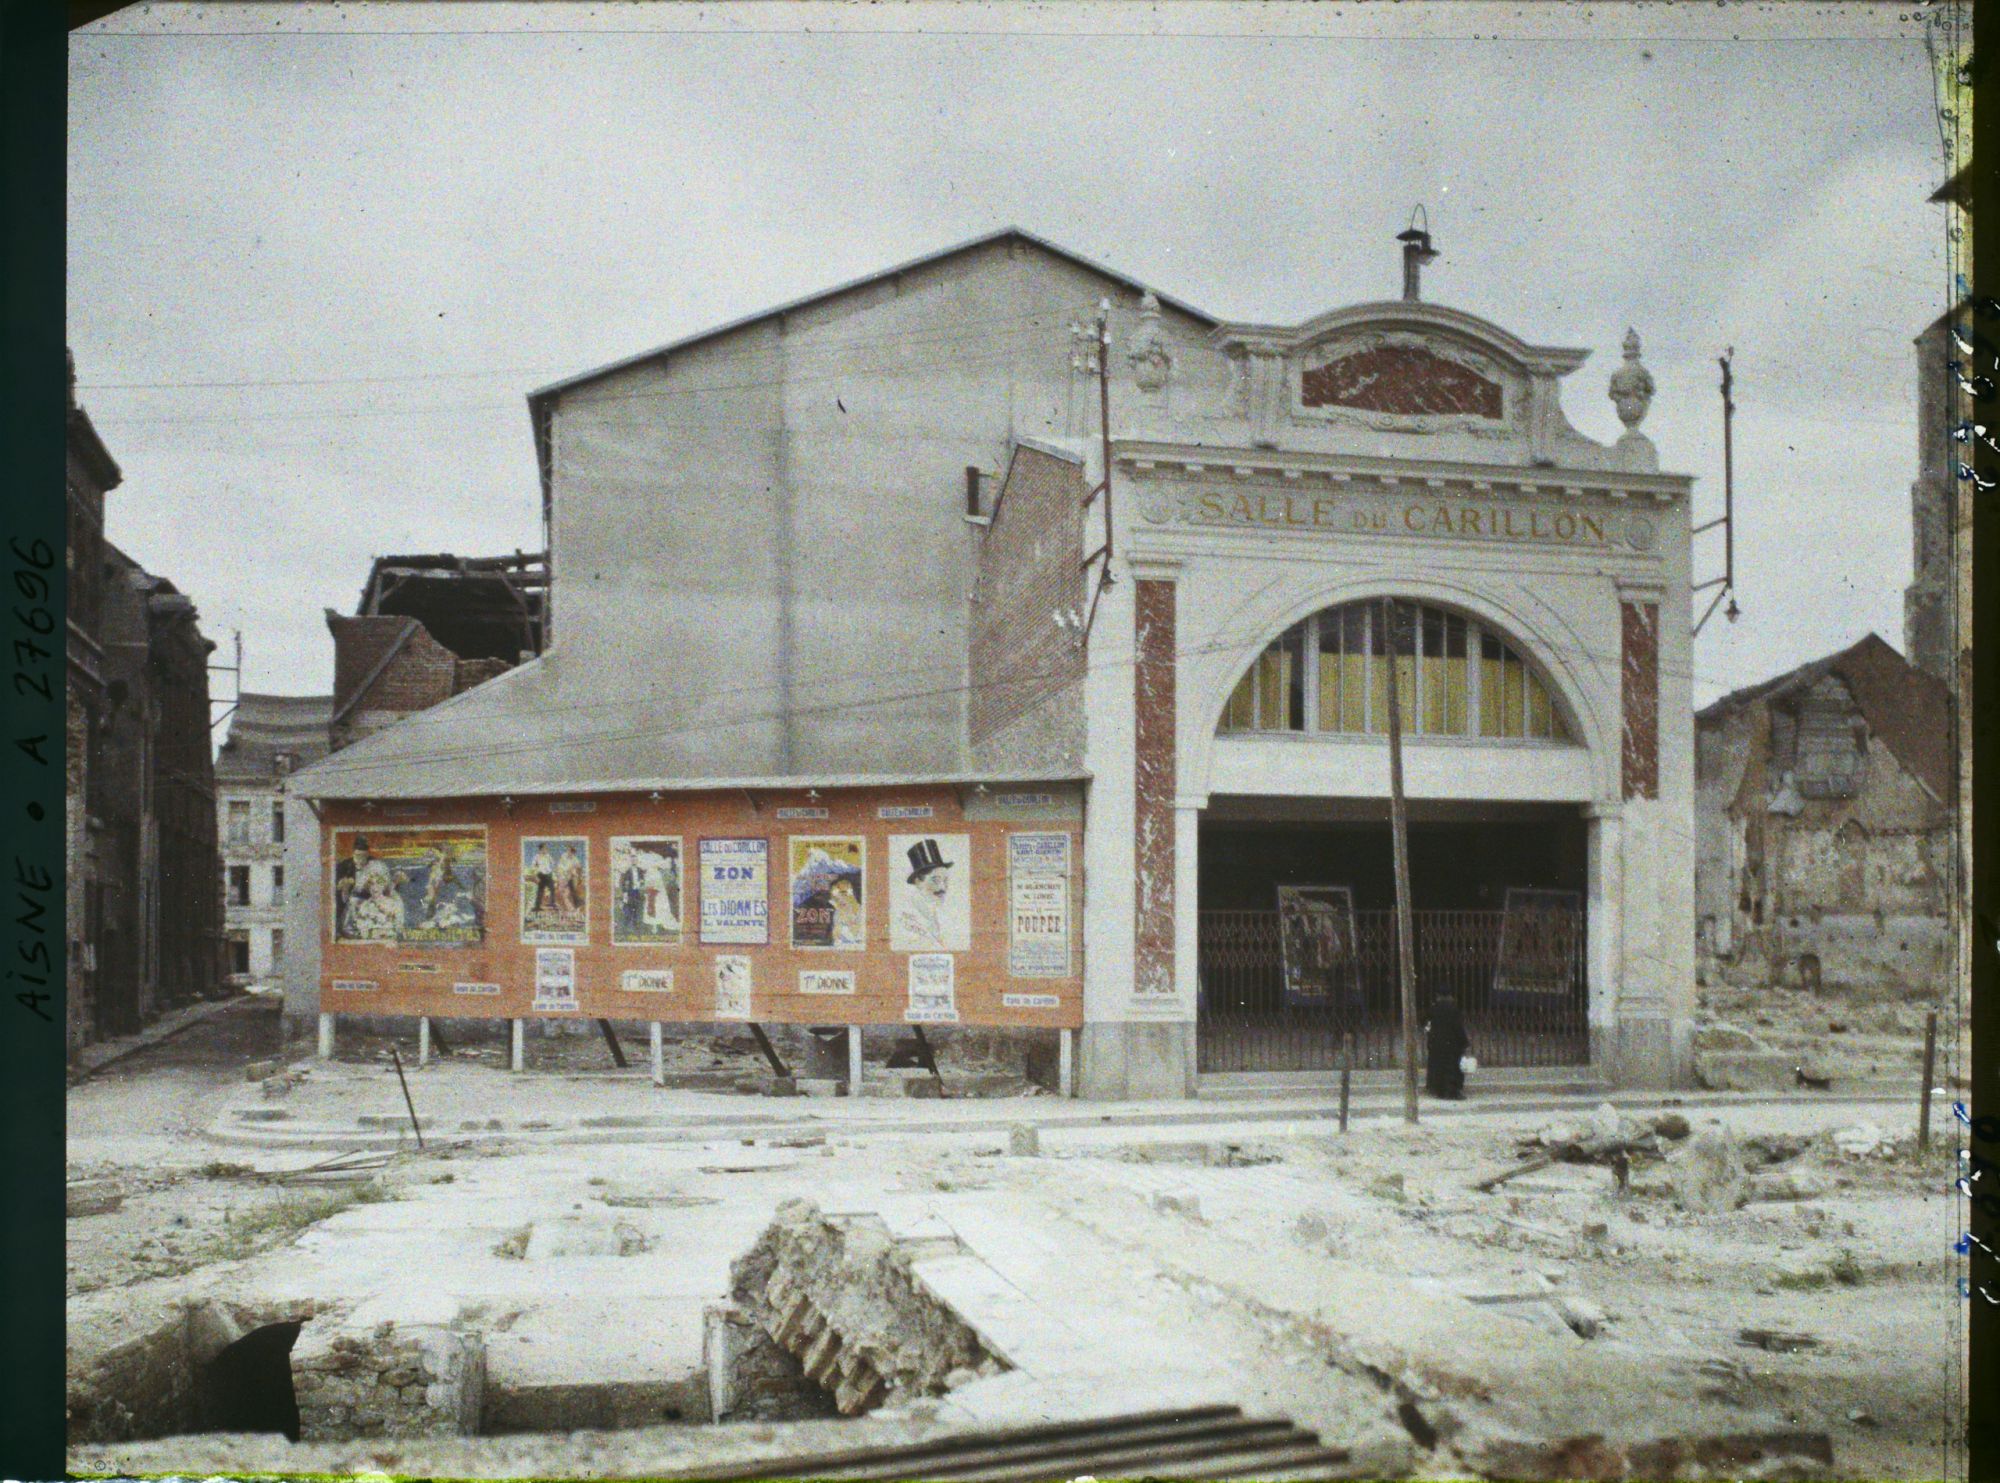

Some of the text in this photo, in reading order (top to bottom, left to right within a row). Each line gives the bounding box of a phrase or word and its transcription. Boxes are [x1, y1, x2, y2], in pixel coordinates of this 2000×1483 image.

[1200, 492, 1334, 525] SALLE
[1403, 504, 1611, 541] CARILLON
[713, 866, 754, 880] ZON
[796, 907, 832, 925] ZON
